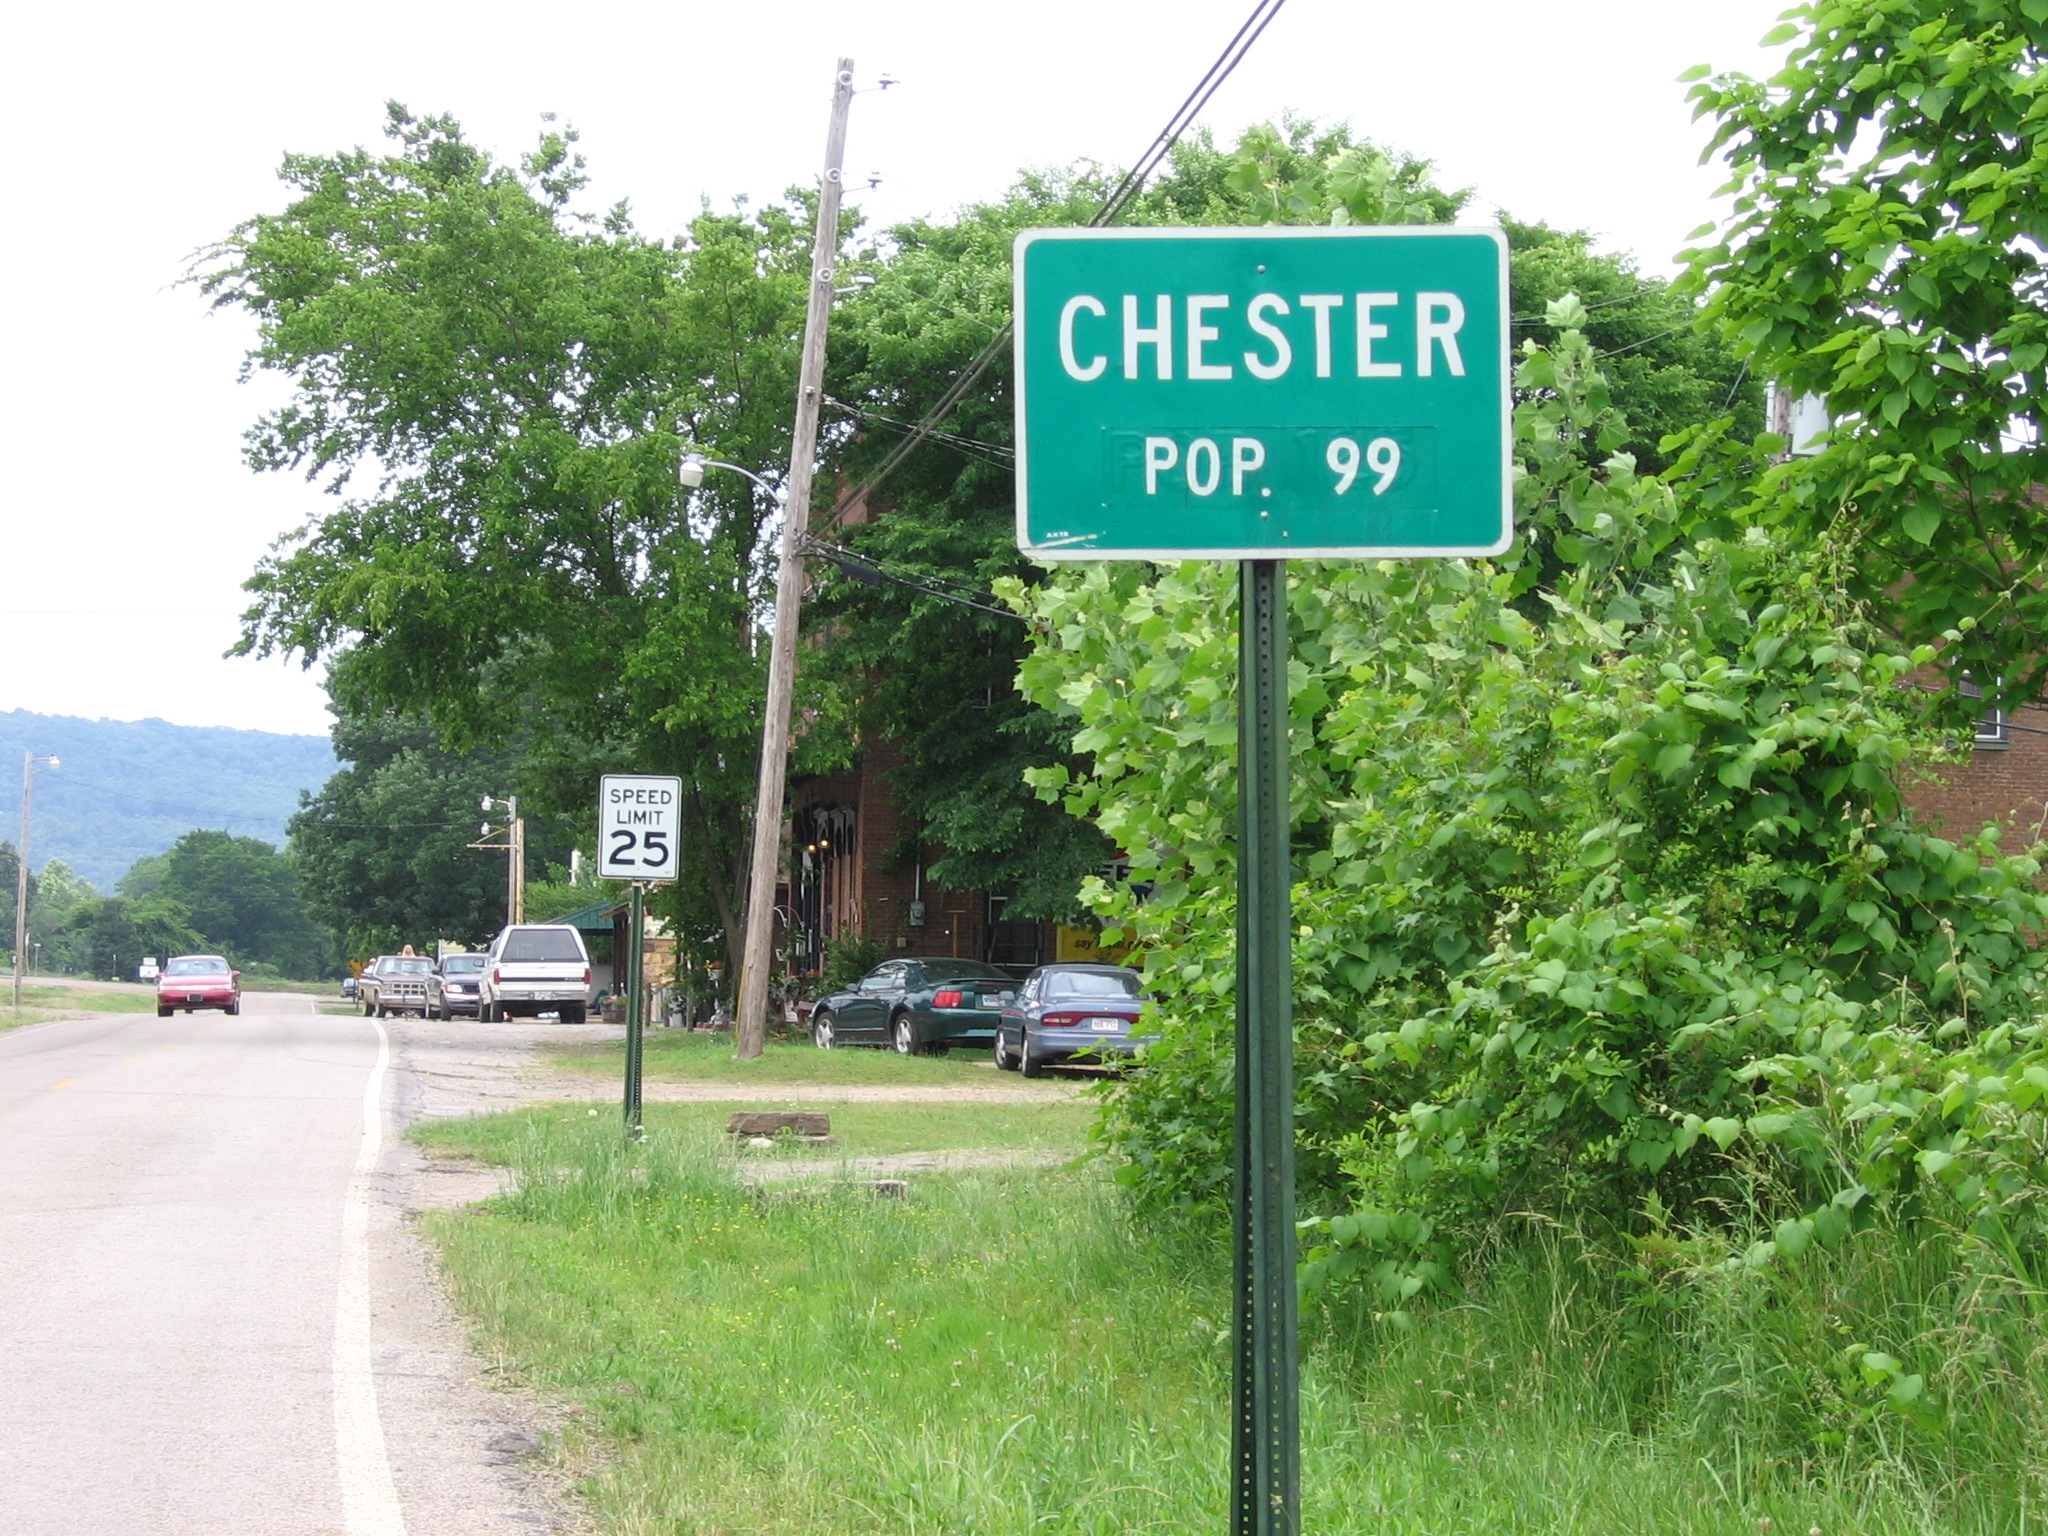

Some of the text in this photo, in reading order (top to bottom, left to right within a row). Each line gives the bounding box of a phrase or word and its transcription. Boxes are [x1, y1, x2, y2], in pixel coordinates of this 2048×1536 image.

[1058, 291, 1466, 382] CHESTER
[1145, 436, 1401, 498] POP. 99
[610, 789, 672, 805] SPEED
[616, 810, 664, 825] LIMIT
[608, 829, 669, 867] 25
[1074, 939, 1093, 951] say
